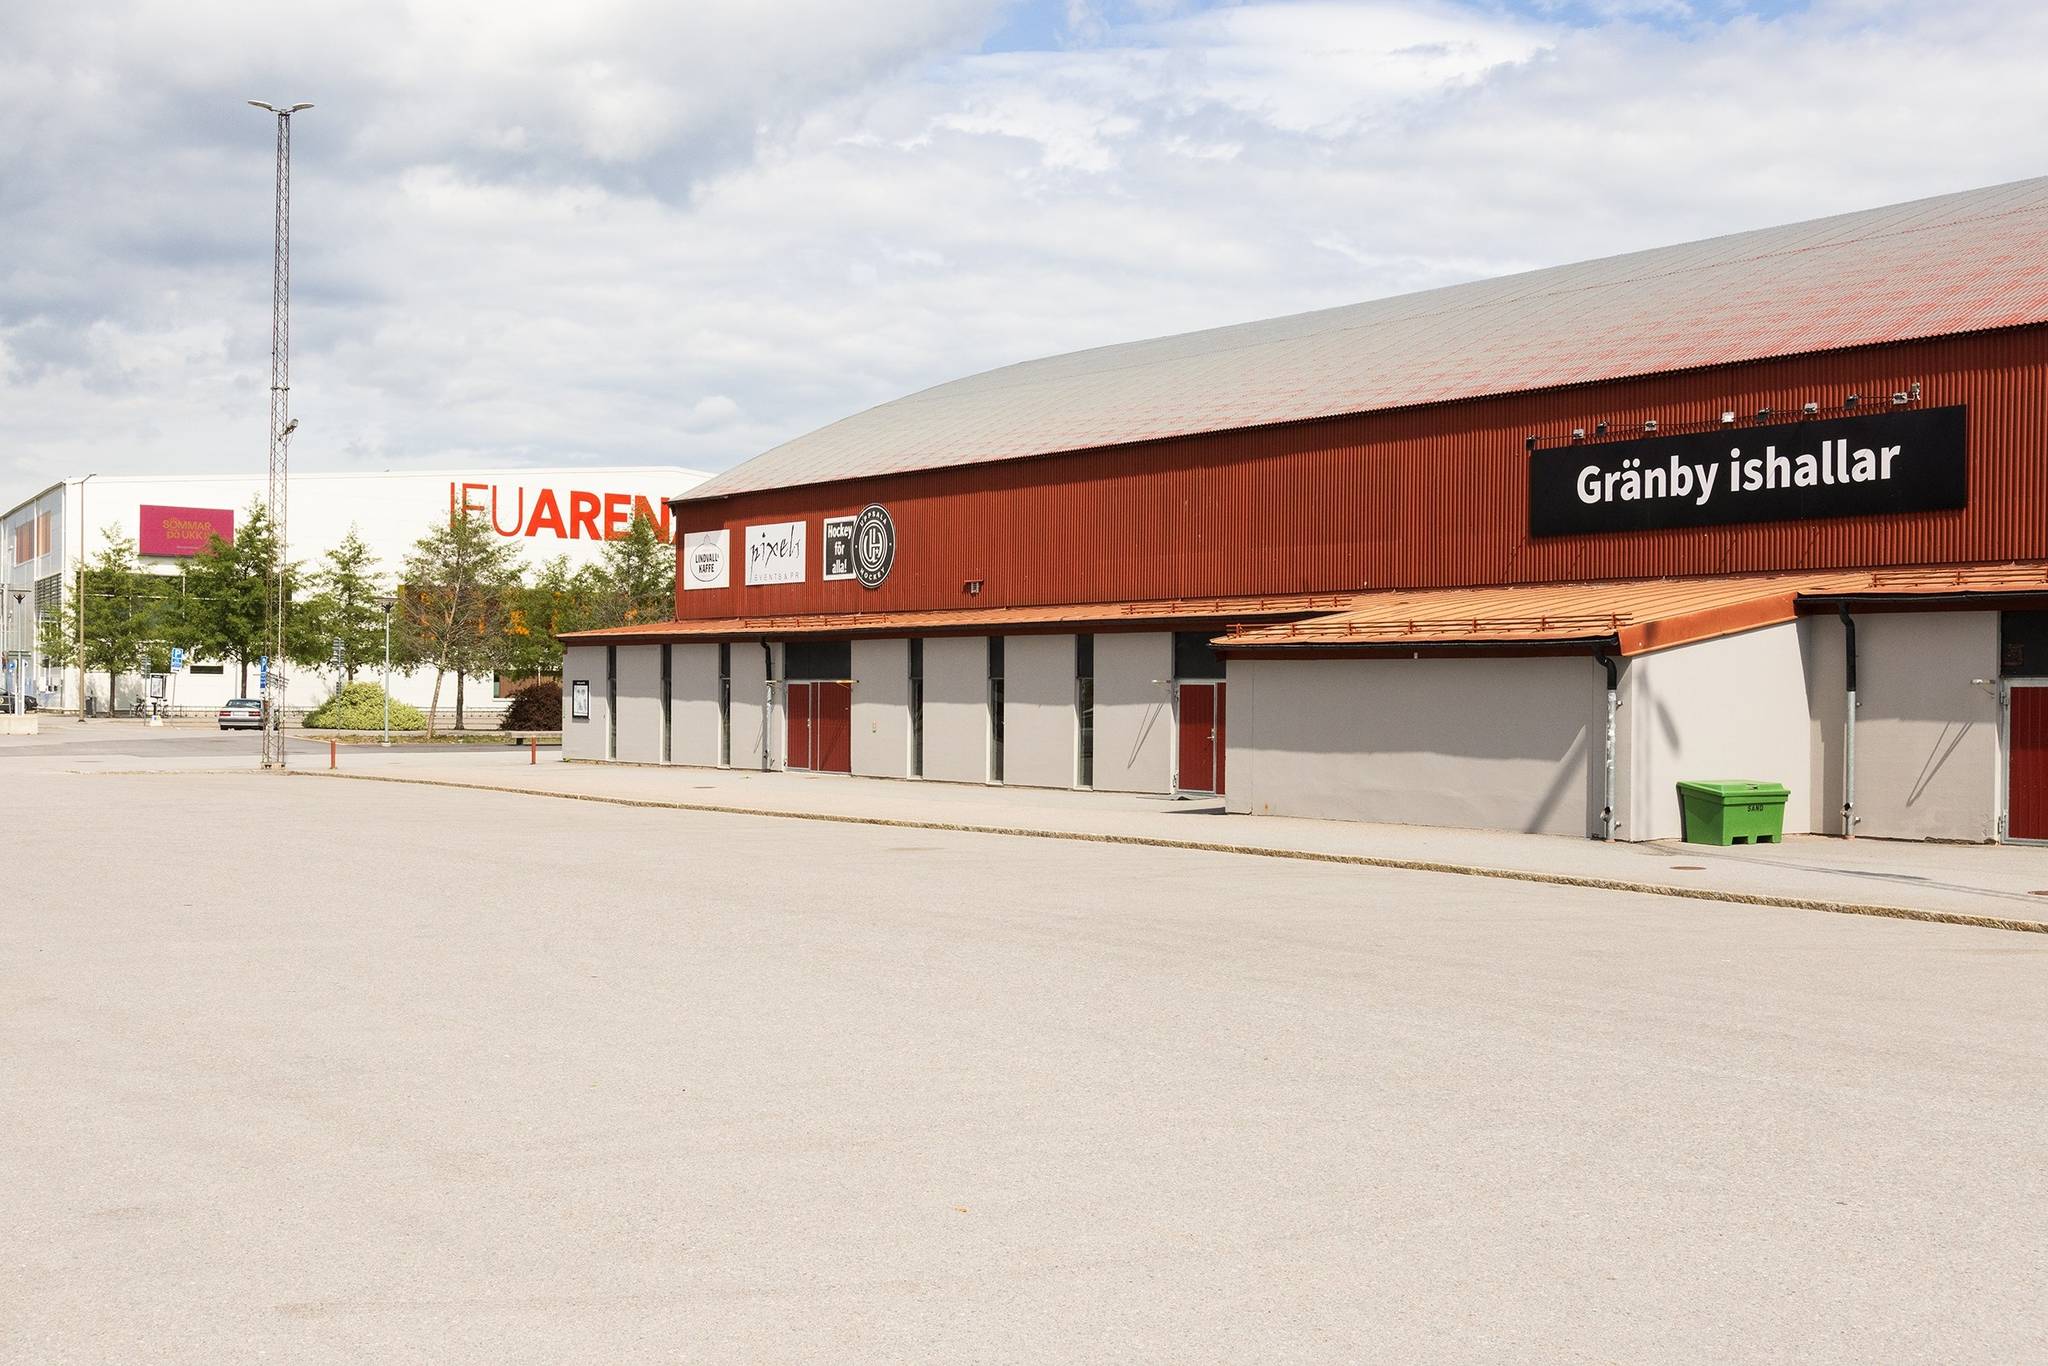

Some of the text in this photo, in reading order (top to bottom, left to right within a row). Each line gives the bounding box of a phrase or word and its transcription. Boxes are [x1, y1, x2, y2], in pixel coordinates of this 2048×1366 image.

[1576, 439, 1901, 506] Gränby ishallar
[450, 481, 677, 545] IFUAREN
[860, 510, 887, 527] UPPSALA
[827, 523, 853, 540] Hockey
[834, 541, 846, 556] för
[698, 563, 715, 573] KAFFE
[831, 559, 848, 574] alla!
[860, 567, 886, 581] HOCKEY
[1747, 804, 1764, 813] SAND
